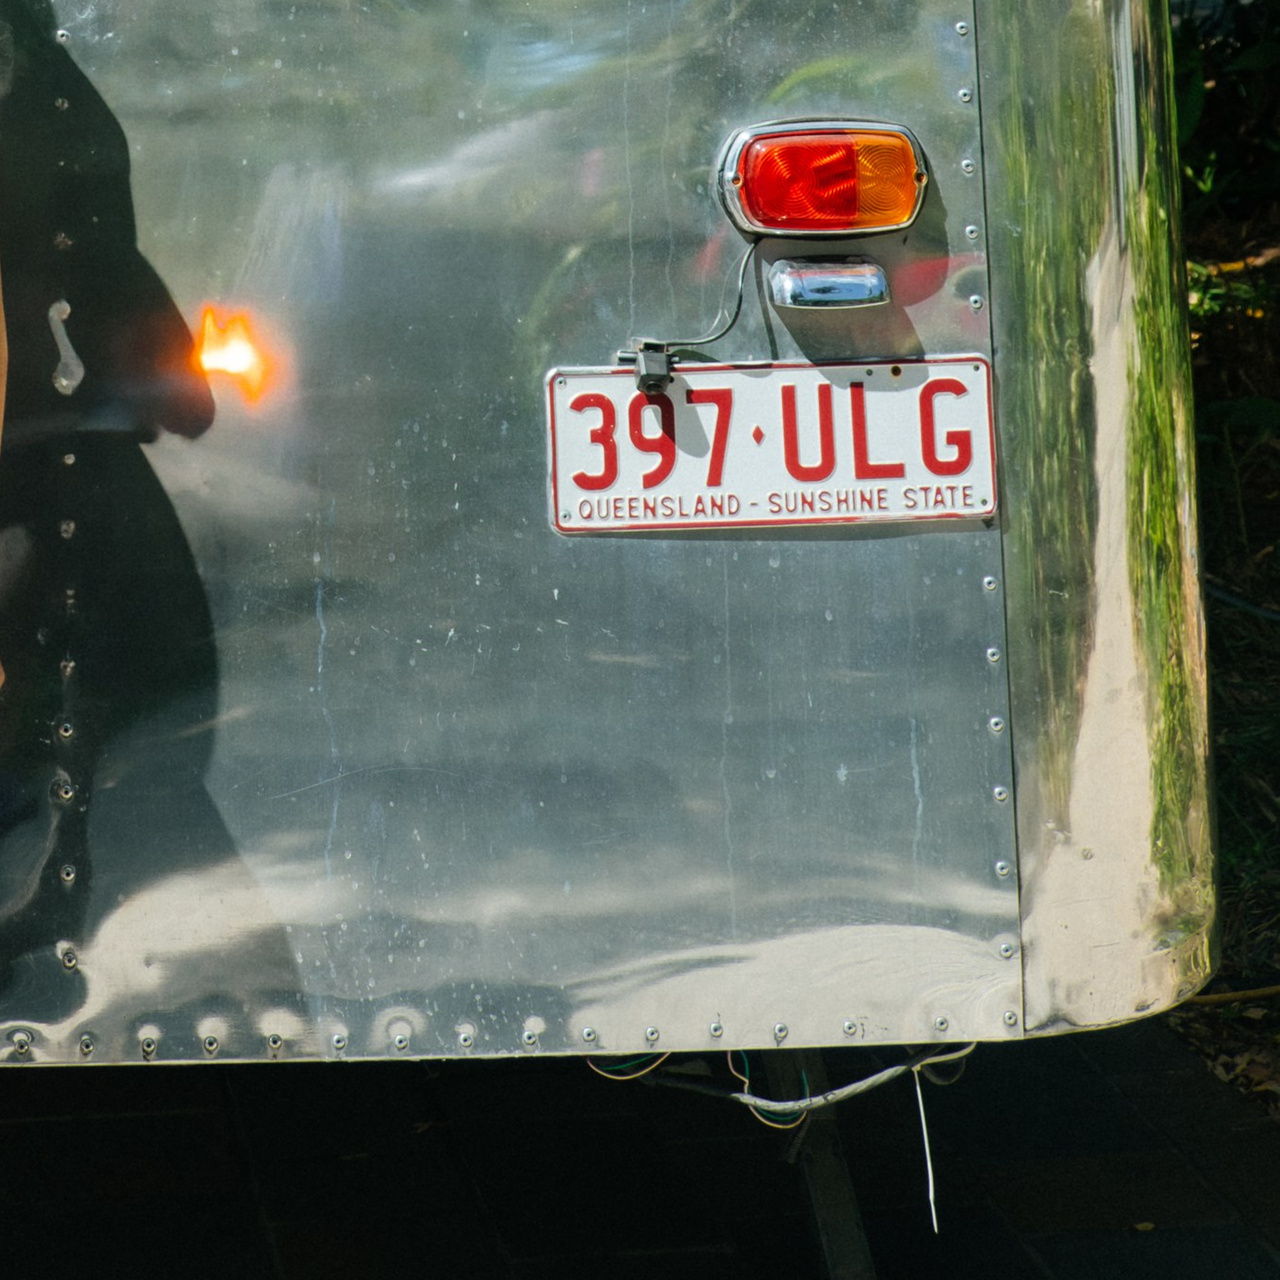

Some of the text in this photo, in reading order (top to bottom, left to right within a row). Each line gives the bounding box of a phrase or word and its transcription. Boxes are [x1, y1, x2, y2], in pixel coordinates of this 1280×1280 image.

[578, 493, 740, 520] QUEENSLAND
[768, 488, 888, 514] SUNSHINE
[903, 485, 975, 509] STATE
